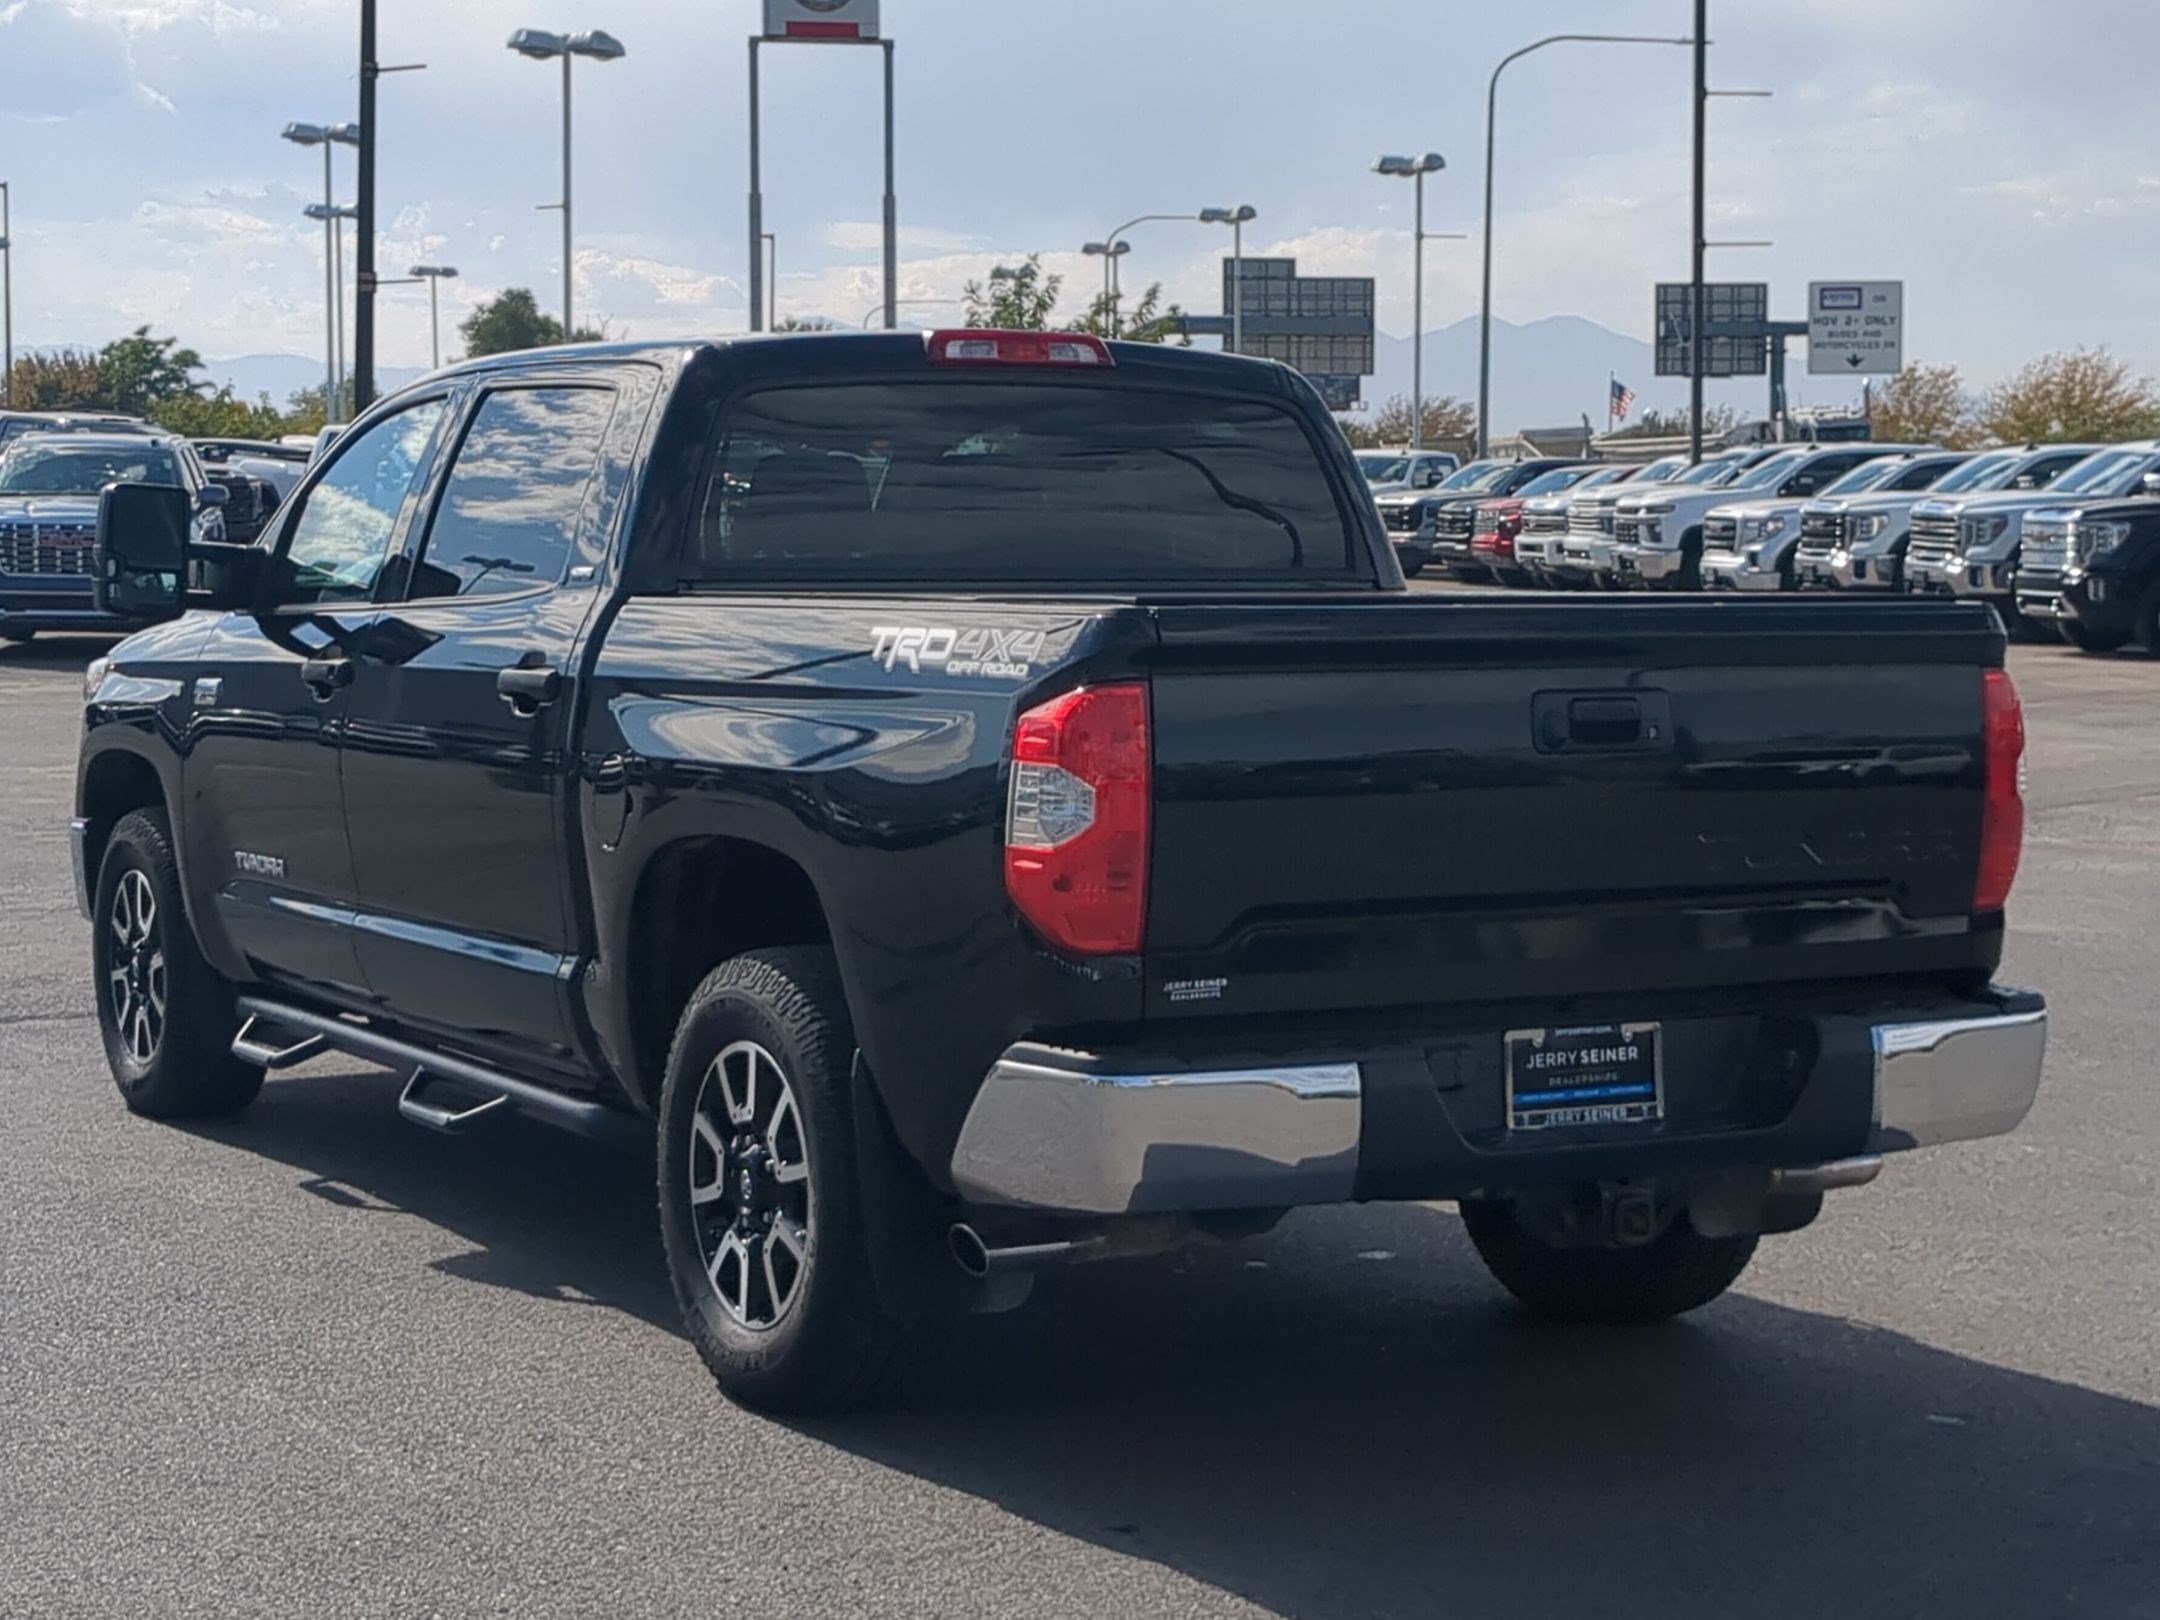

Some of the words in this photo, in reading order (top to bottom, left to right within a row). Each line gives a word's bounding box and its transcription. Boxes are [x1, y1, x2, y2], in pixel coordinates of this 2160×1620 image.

[1813, 315, 1838, 326] HOV
[1865, 315, 1897, 326] ONLY
[870, 627, 957, 674] TRD
[946, 661, 981, 676] OFF
[980, 663, 1029, 679] ROAD
[1163, 981, 1193, 992] JERRY
[1526, 1050, 1577, 1070] JERRY
[1580, 1046, 1639, 1065] SEINER
[1543, 1112, 1581, 1127] JERRY
[1584, 1106, 1628, 1123] SEINER
